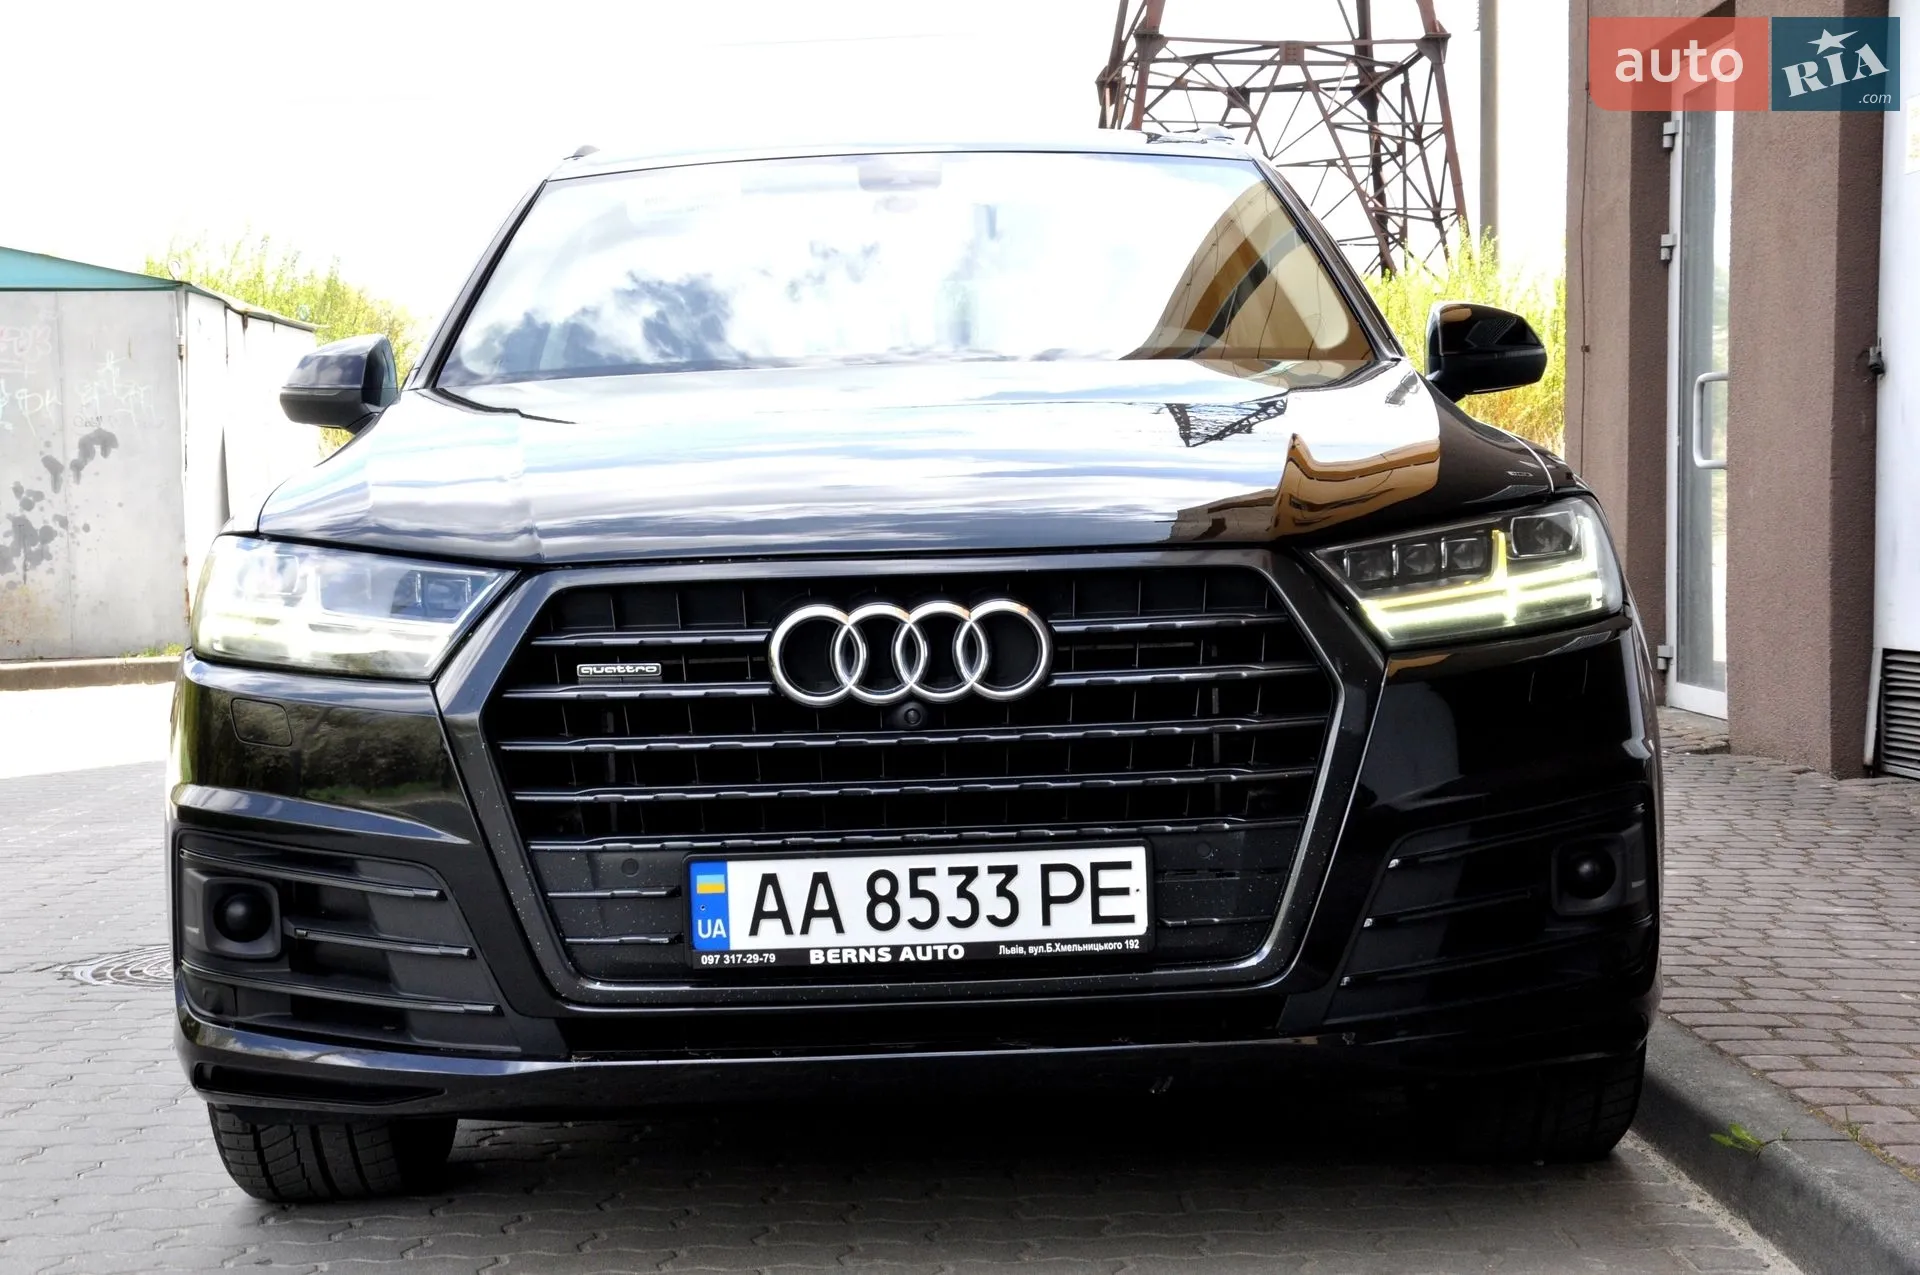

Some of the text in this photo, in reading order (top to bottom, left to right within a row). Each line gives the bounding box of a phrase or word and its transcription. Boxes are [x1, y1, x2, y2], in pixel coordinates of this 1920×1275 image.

[580, 666, 657, 675] quattro
[748, 861, 1136, 936] AA 8533 PE
[697, 919, 727, 938] UA
[809, 944, 965, 965] BERNS AUTO
[999, 945, 1026, 955] Львів,
[1124, 939, 1140, 949] 192
[701, 953, 776, 965] 097 317-29-79
